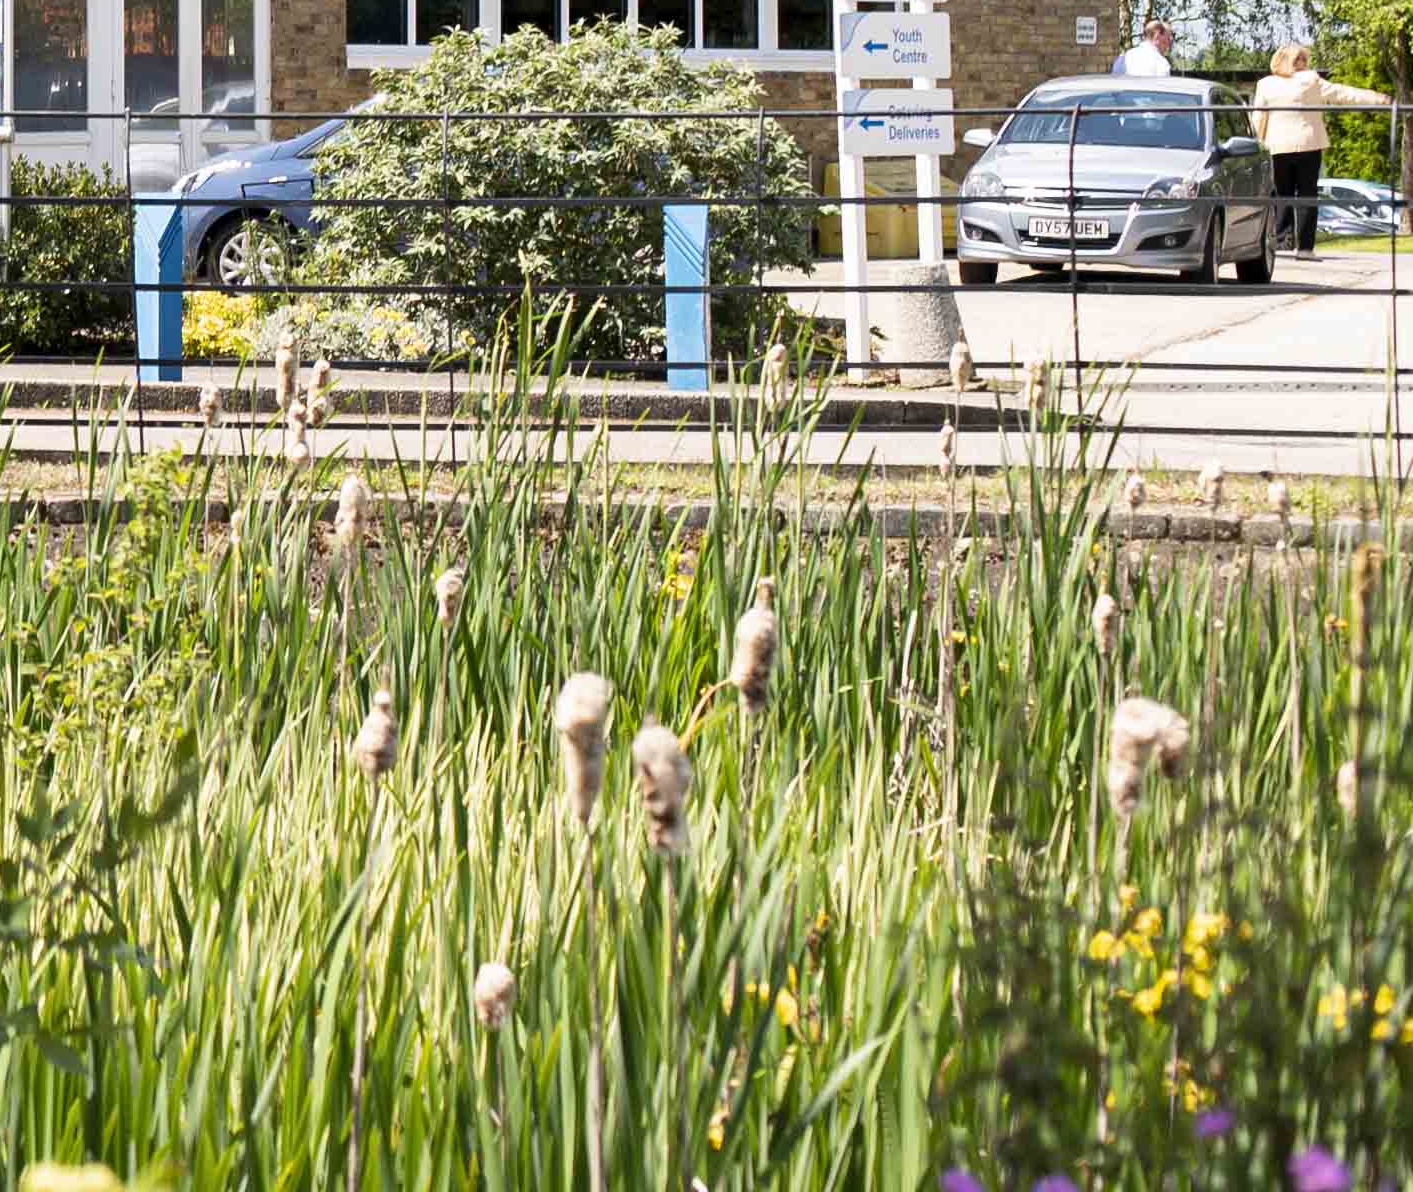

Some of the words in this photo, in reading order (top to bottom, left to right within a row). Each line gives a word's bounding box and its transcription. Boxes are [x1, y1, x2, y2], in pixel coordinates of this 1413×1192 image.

[892, 29, 923, 43] Youth
[892, 49, 928, 64] Centre
[888, 126, 940, 141] Deliveries
